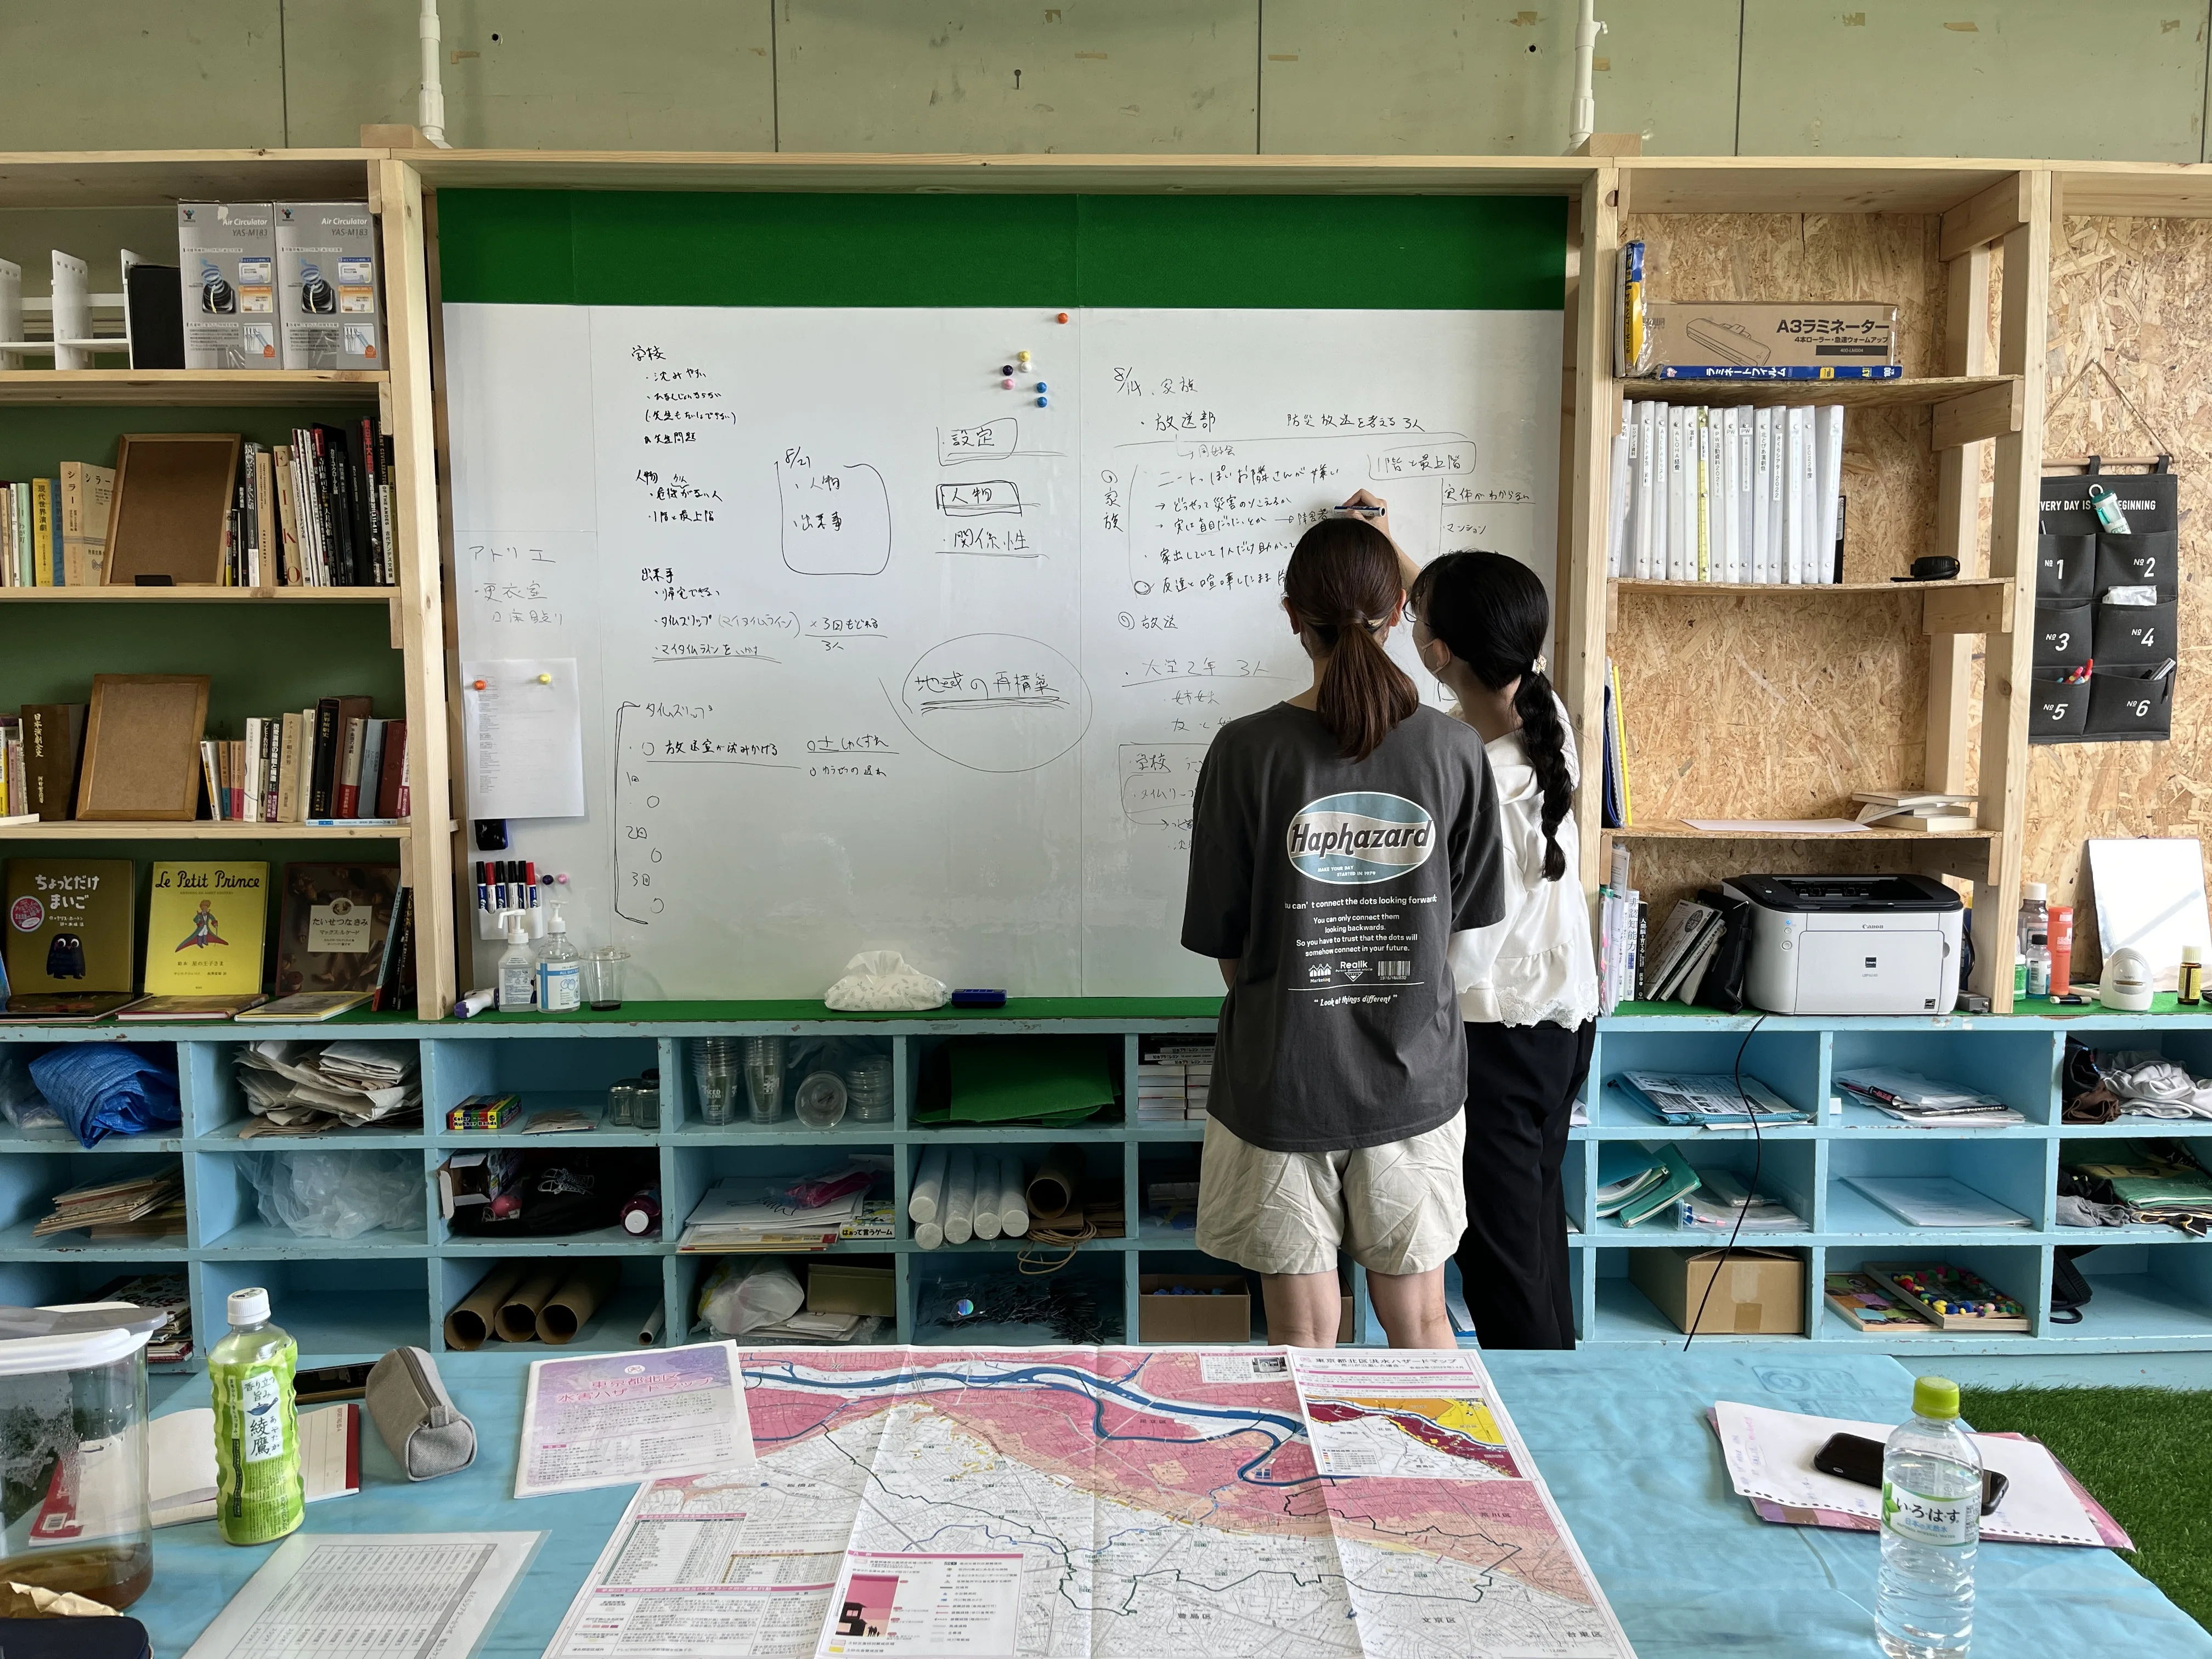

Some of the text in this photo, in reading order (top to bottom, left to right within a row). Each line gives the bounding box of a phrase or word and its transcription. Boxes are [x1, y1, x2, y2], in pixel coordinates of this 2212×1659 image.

[232, 229, 268, 237] YAS-M183
[331, 228, 368, 236] YAS-M183
[1776, 319, 1889, 334] A3ラミネーター
[631, 345, 666, 361] 学校
[1706, 366, 1786, 378] ラミネートフィルム
[2064, 500, 2080, 511] DAY
[2083, 500, 2091, 510] IS
[469, 546, 556, 563] アトリエ
[2056, 559, 2064, 580] 1
[2144, 557, 2156, 578] 2
[2055, 632, 2070, 651] 3
[2141, 627, 2154, 647] 4
[2052, 703, 2068, 721] 5
[2135, 698, 2151, 718] 6
[1291, 820, 1434, 860] Haphazard
[35, 874, 100, 890] ちょっとだけ
[155, 870, 260, 888] Le Petit Prince
[50, 894, 89, 910] まいご
[1316, 898, 1344, 907] connect
[1359, 896, 1377, 906] dots
[1379, 895, 1407, 905] looking
[312, 917, 369, 927] たいせつなきみ
[1313, 916, 1325, 924] You
[1338, 915, 1351, 924] only
[1352, 913, 1378, 922] connect
[1627, 898, 1639, 951] 非認知能力
[1325, 923, 1386, 934] looking backwards.
[1296, 939, 1305, 947] So
[1306, 940, 1318, 948] you
[1319, 936, 1333, 945] have
[1406, 933, 1418, 941] will
[1305, 947, 1334, 957] somehow
[1334, 946, 1361, 954] connect
[1369, 945, 1385, 954] your
[1386, 944, 1410, 952] future.
[1320, 997, 1335, 1007] Look
[1341, 996, 1361, 1005] things
[1362, 995, 1392, 1005] different
[842, 1228, 893, 1236] はぁって言うゲーム
[243, 1376, 275, 1392] 香り立つ
[591, 1373, 680, 1389] 東京都北区
[253, 1391, 272, 1402] 旨み
[558, 1376, 712, 1403] 水害ハザードマップ
[250, 1419, 270, 1457] 綾鷹
[270, 1415, 280, 1451] あやたか
[1905, 1517, 1948, 1533] 日本の天然水
